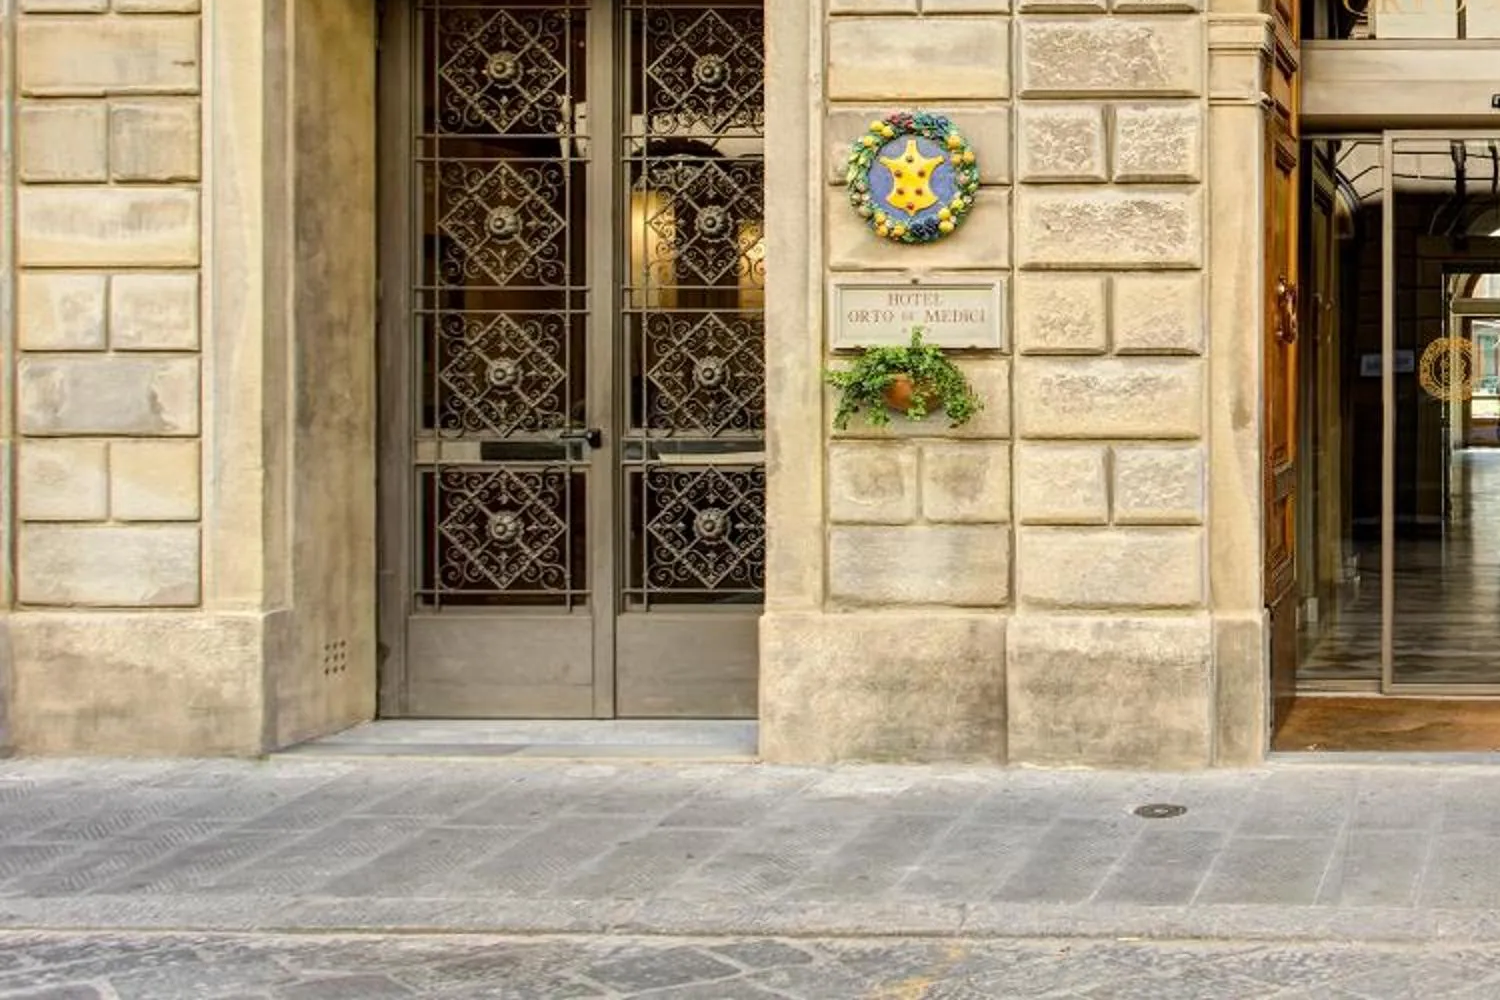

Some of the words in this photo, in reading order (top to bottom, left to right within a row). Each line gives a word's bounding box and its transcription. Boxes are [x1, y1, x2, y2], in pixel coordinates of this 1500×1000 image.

[888, 293, 943, 306] HOTEL
[848, 311, 895, 323] ORTO
[925, 309, 986, 323] MEDICI
